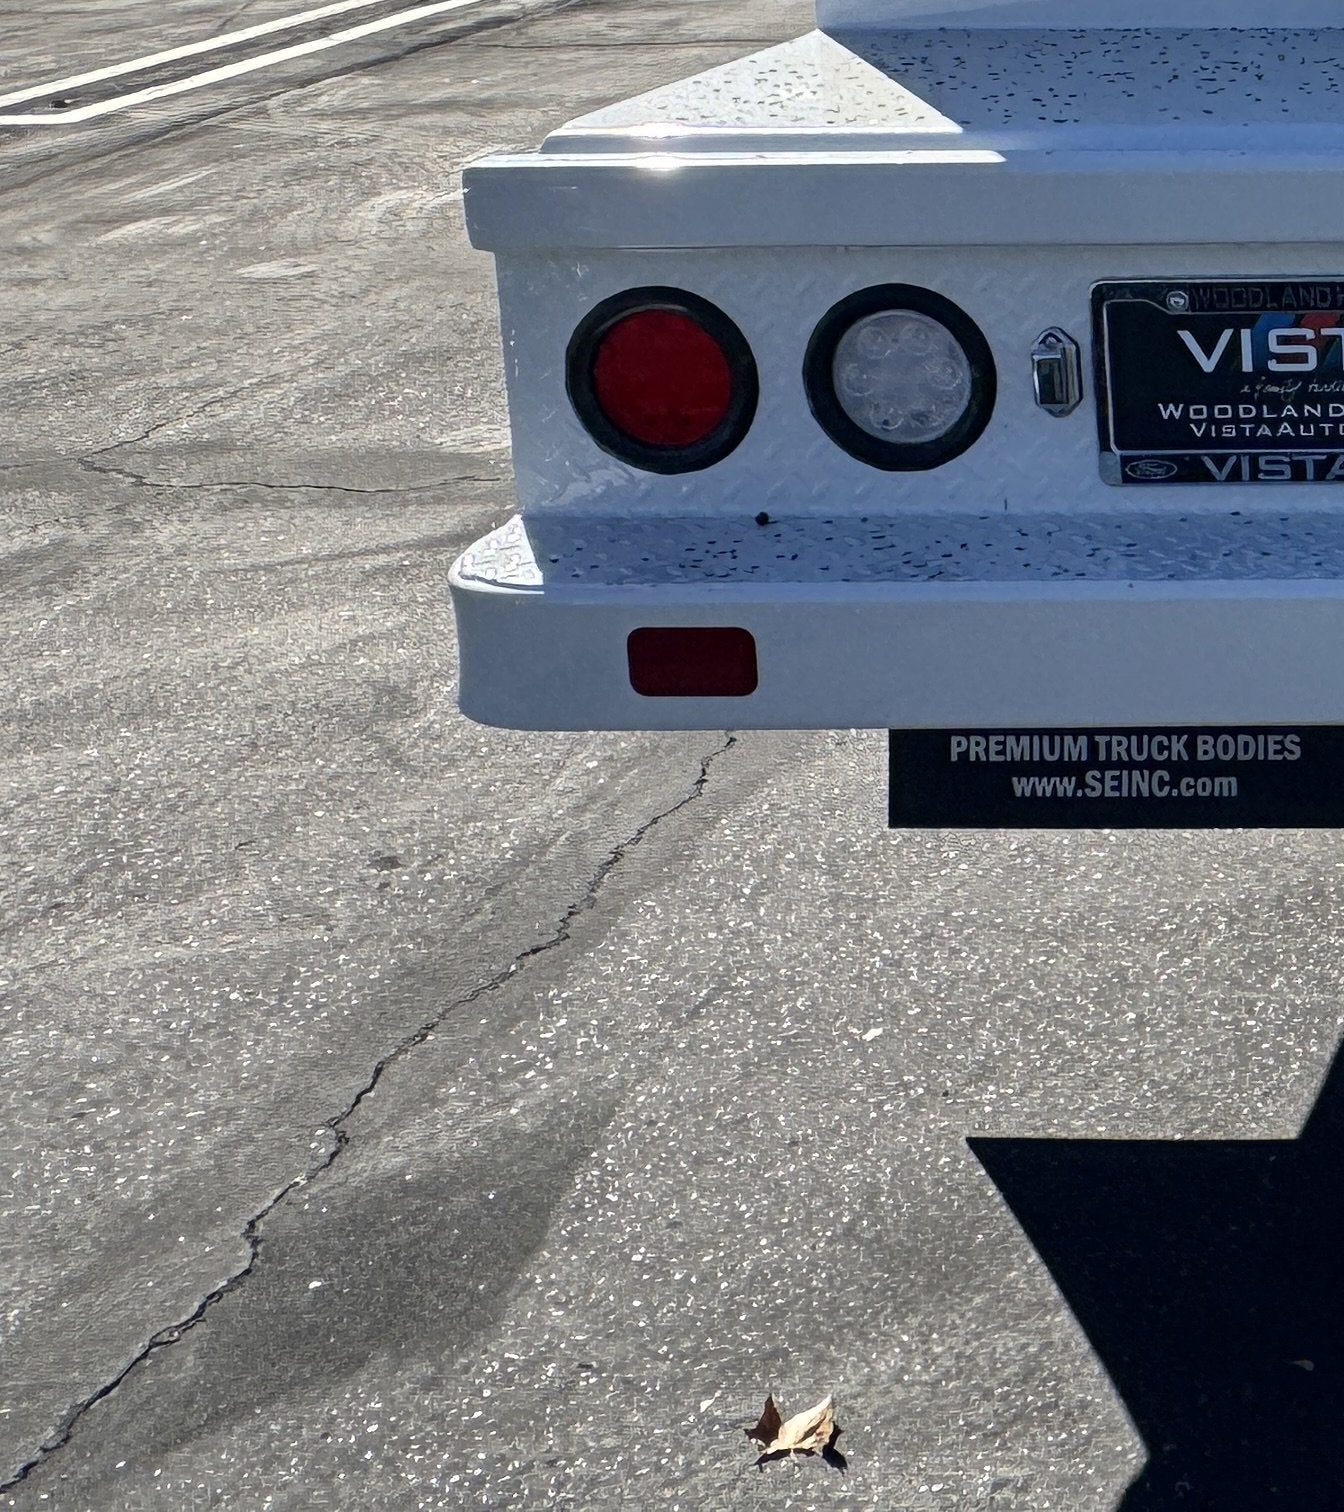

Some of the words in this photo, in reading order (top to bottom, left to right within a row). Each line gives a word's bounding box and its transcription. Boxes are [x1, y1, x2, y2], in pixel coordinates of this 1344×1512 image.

[1191, 286, 1332, 310] WOODLAND
[950, 735, 1088, 762] PREMIUM
[1094, 735, 1188, 761] TRUCK
[1197, 734, 1301, 760] BODIES
[1012, 769, 1238, 798] www.SEINC.com
